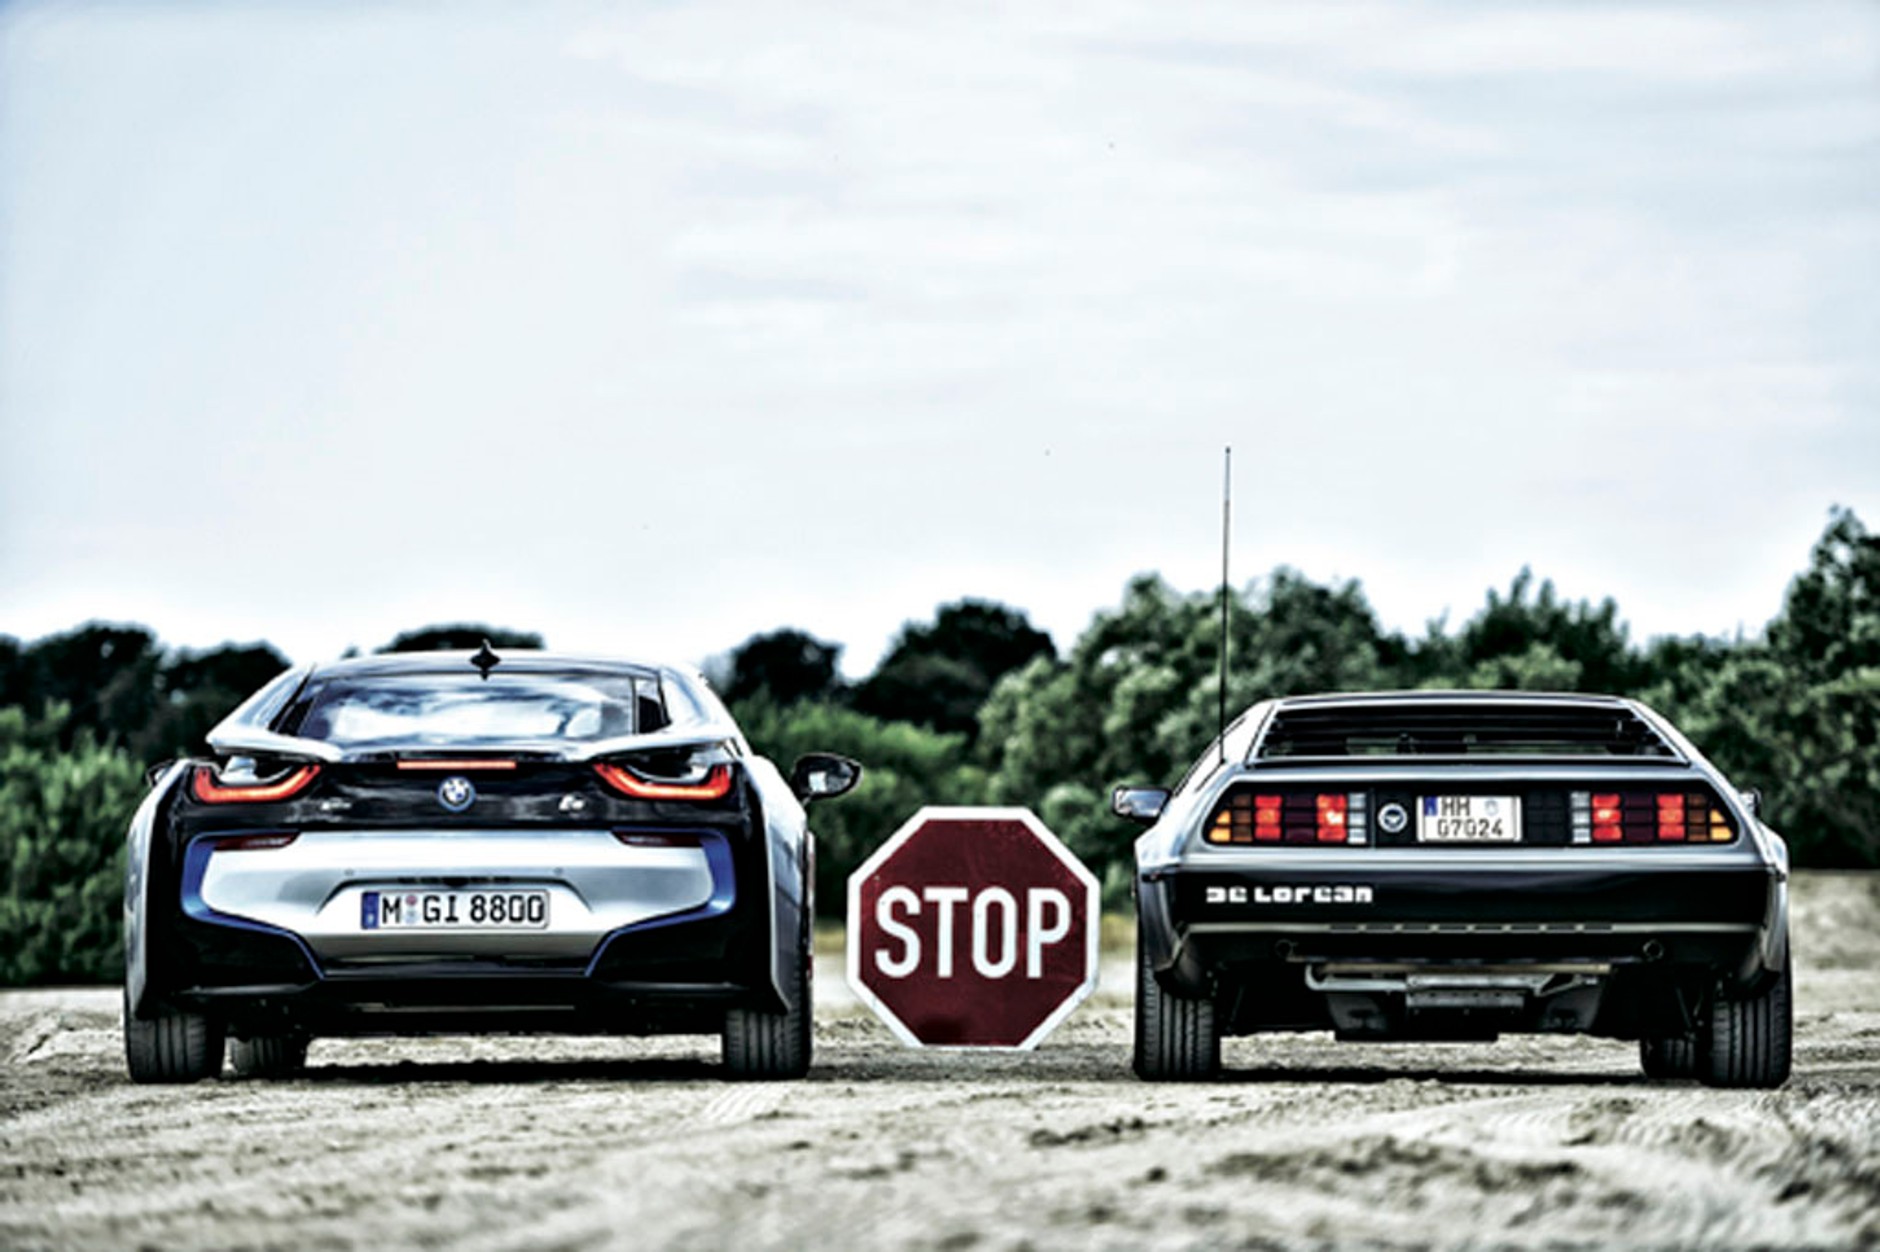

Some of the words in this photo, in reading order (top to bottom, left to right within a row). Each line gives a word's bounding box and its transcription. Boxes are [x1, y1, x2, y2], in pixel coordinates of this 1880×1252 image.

[1441, 795, 1471, 817] HH
[382, 895, 401, 924] M
[422, 894, 460, 923] GI
[469, 894, 545, 923] 8800
[875, 886, 1071, 979] STOP
